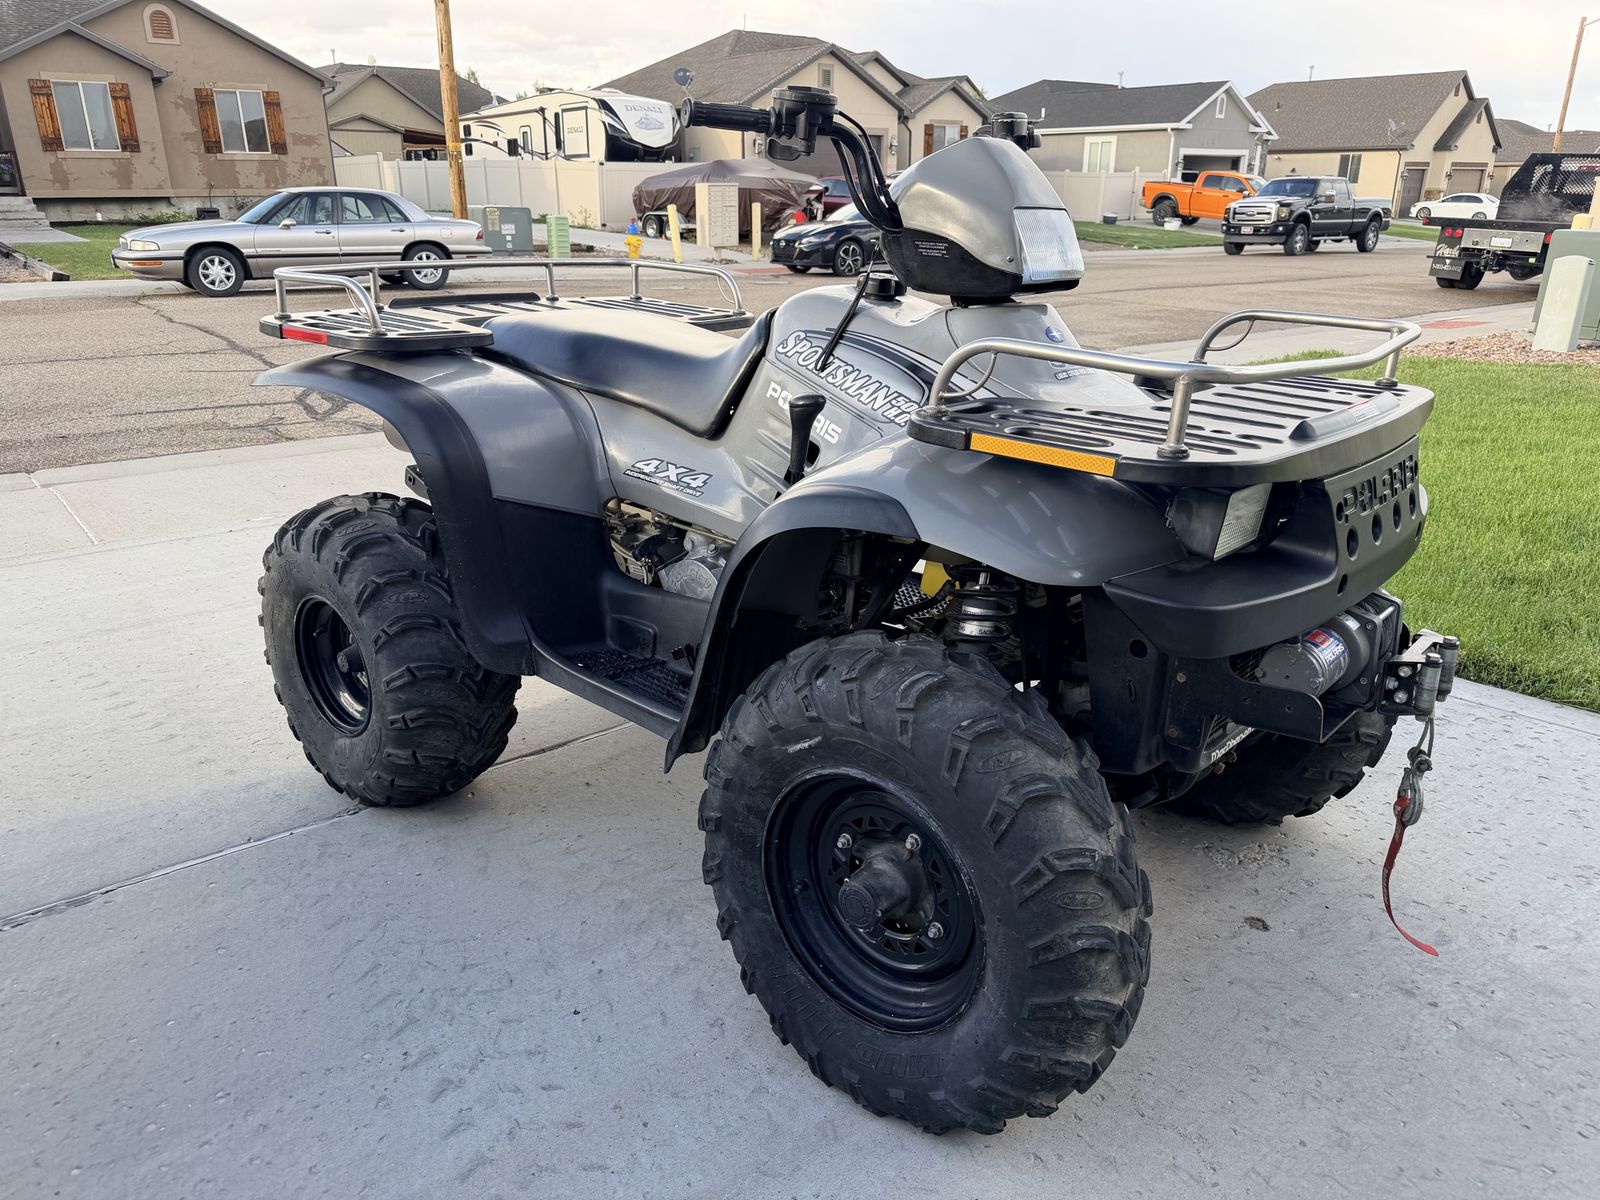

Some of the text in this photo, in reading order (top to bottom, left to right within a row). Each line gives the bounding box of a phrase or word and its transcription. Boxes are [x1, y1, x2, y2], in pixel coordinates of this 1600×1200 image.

[624, 104, 663, 114] DENALI
[766, 381, 843, 444] PORIS
[631, 458, 713, 489] 4X4
[1343, 454, 1415, 525] POLARIS
